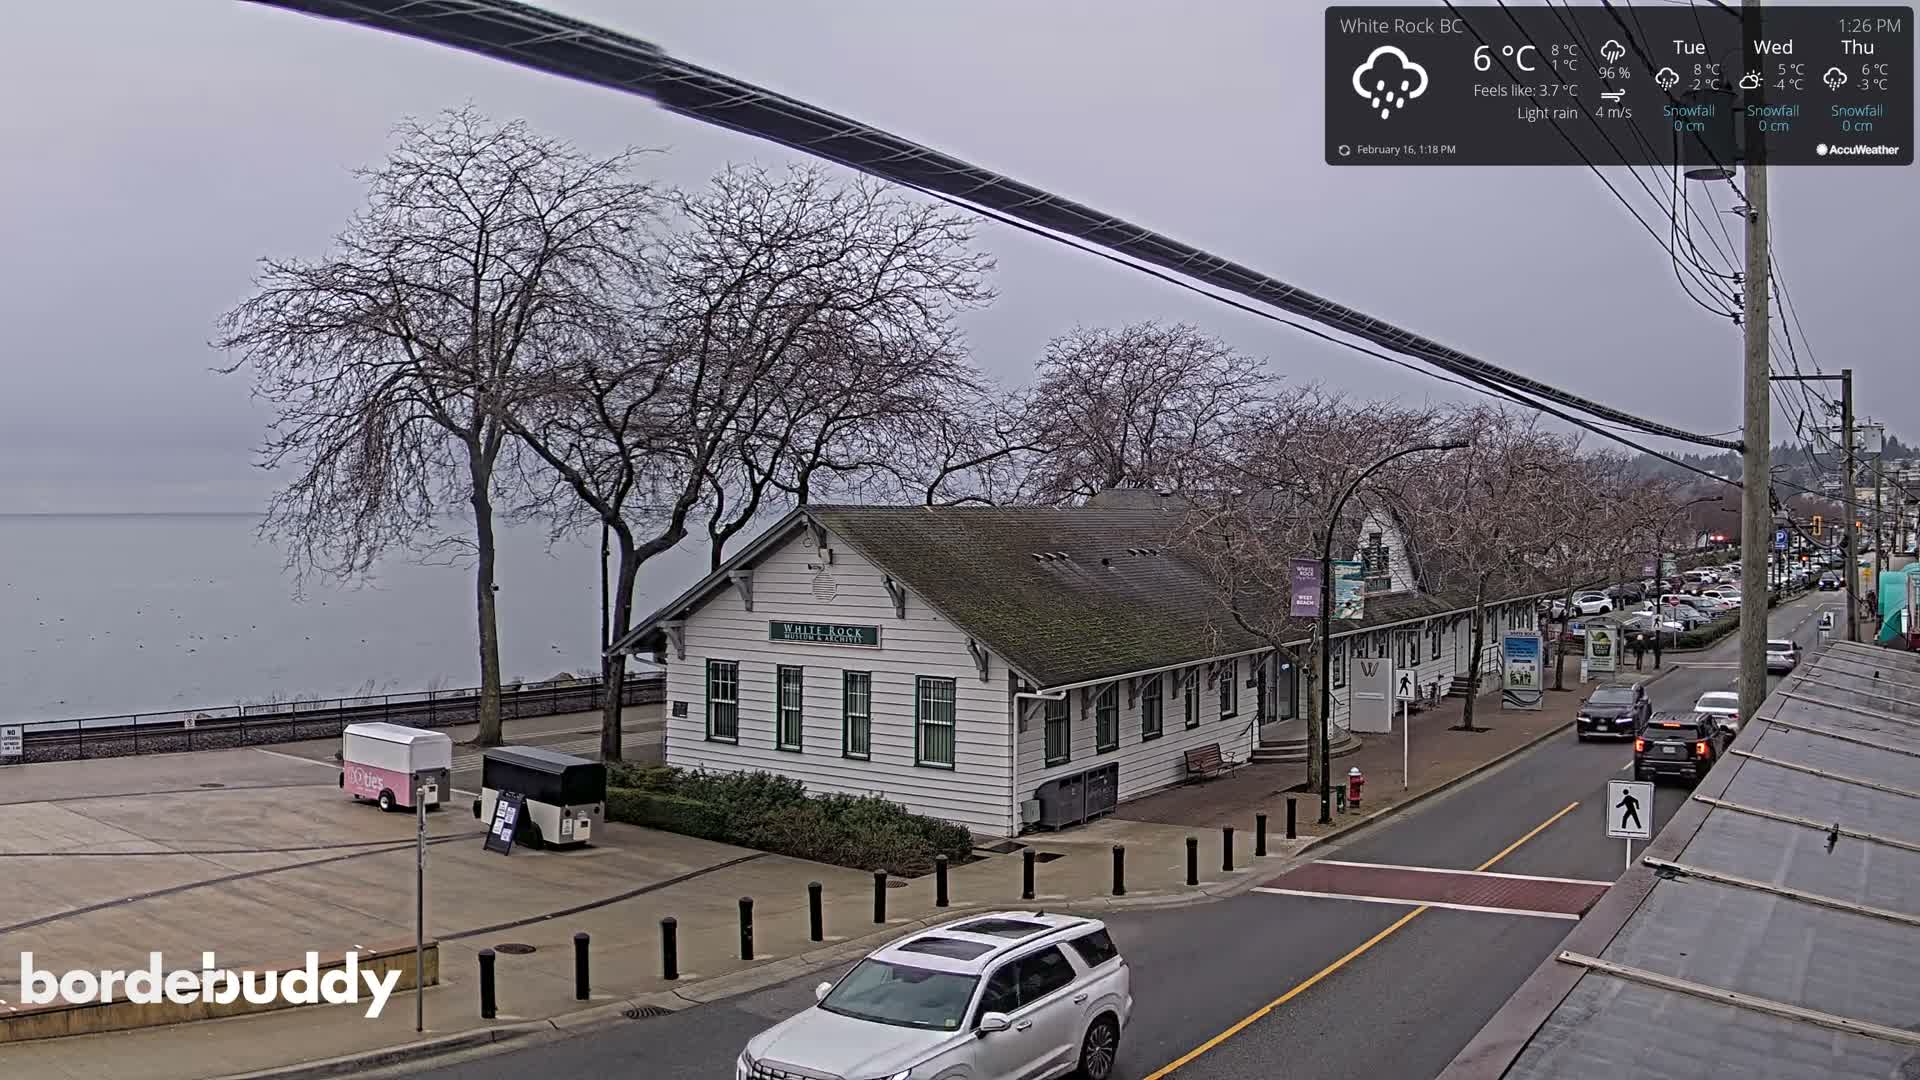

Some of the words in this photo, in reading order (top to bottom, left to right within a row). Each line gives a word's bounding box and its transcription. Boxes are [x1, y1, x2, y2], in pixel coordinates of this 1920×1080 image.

[784, 633, 814, 641] MUSEUM
[825, 635, 863, 644] ARCHIVES
[1360, 661, 1380, 678] W
